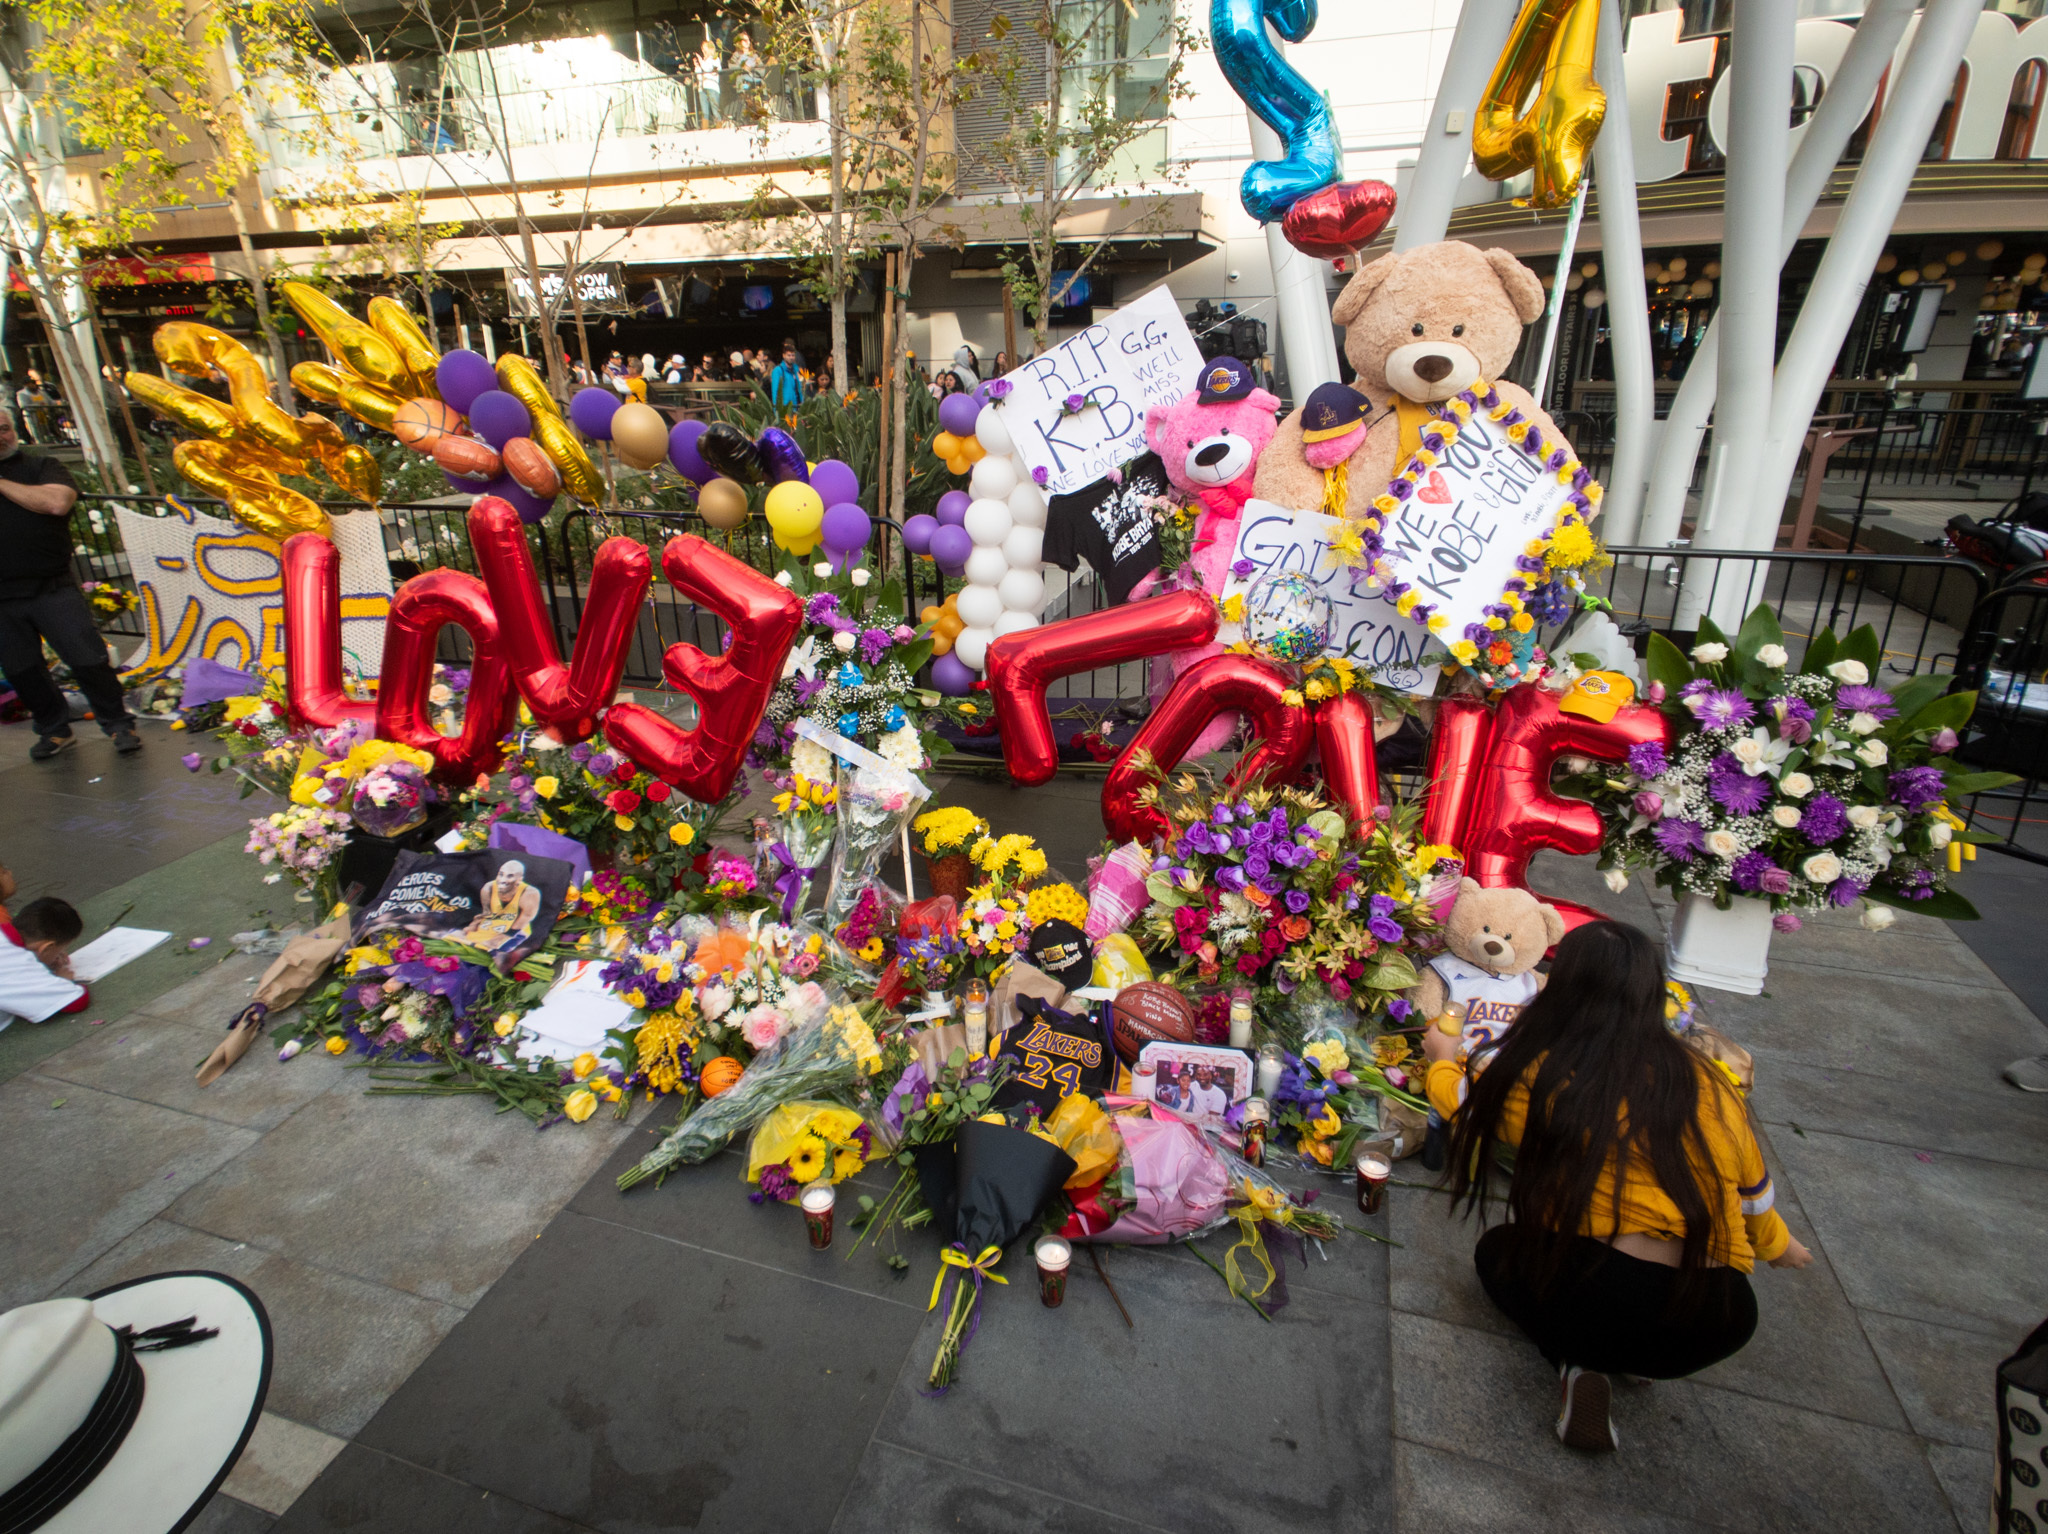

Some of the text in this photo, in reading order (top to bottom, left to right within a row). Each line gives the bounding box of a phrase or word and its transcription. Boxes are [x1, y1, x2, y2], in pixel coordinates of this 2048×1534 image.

[1563, 303, 1578, 356] UPSTAIRS
[1143, 371, 1181, 397] MISS
[1557, 356, 1570, 393] FLOOR
[1048, 470, 1076, 493] WE
[1082, 448, 1124, 479] LOVE
[1382, 418, 1493, 563] WE YOU
[1111, 531, 1134, 562] KOBE
[1416, 499, 1498, 601] KOBE
[389, 885, 426, 901] COME
[1016, 1022, 1103, 1069] LAKERS
[1018, 1052, 1082, 1100] 24
